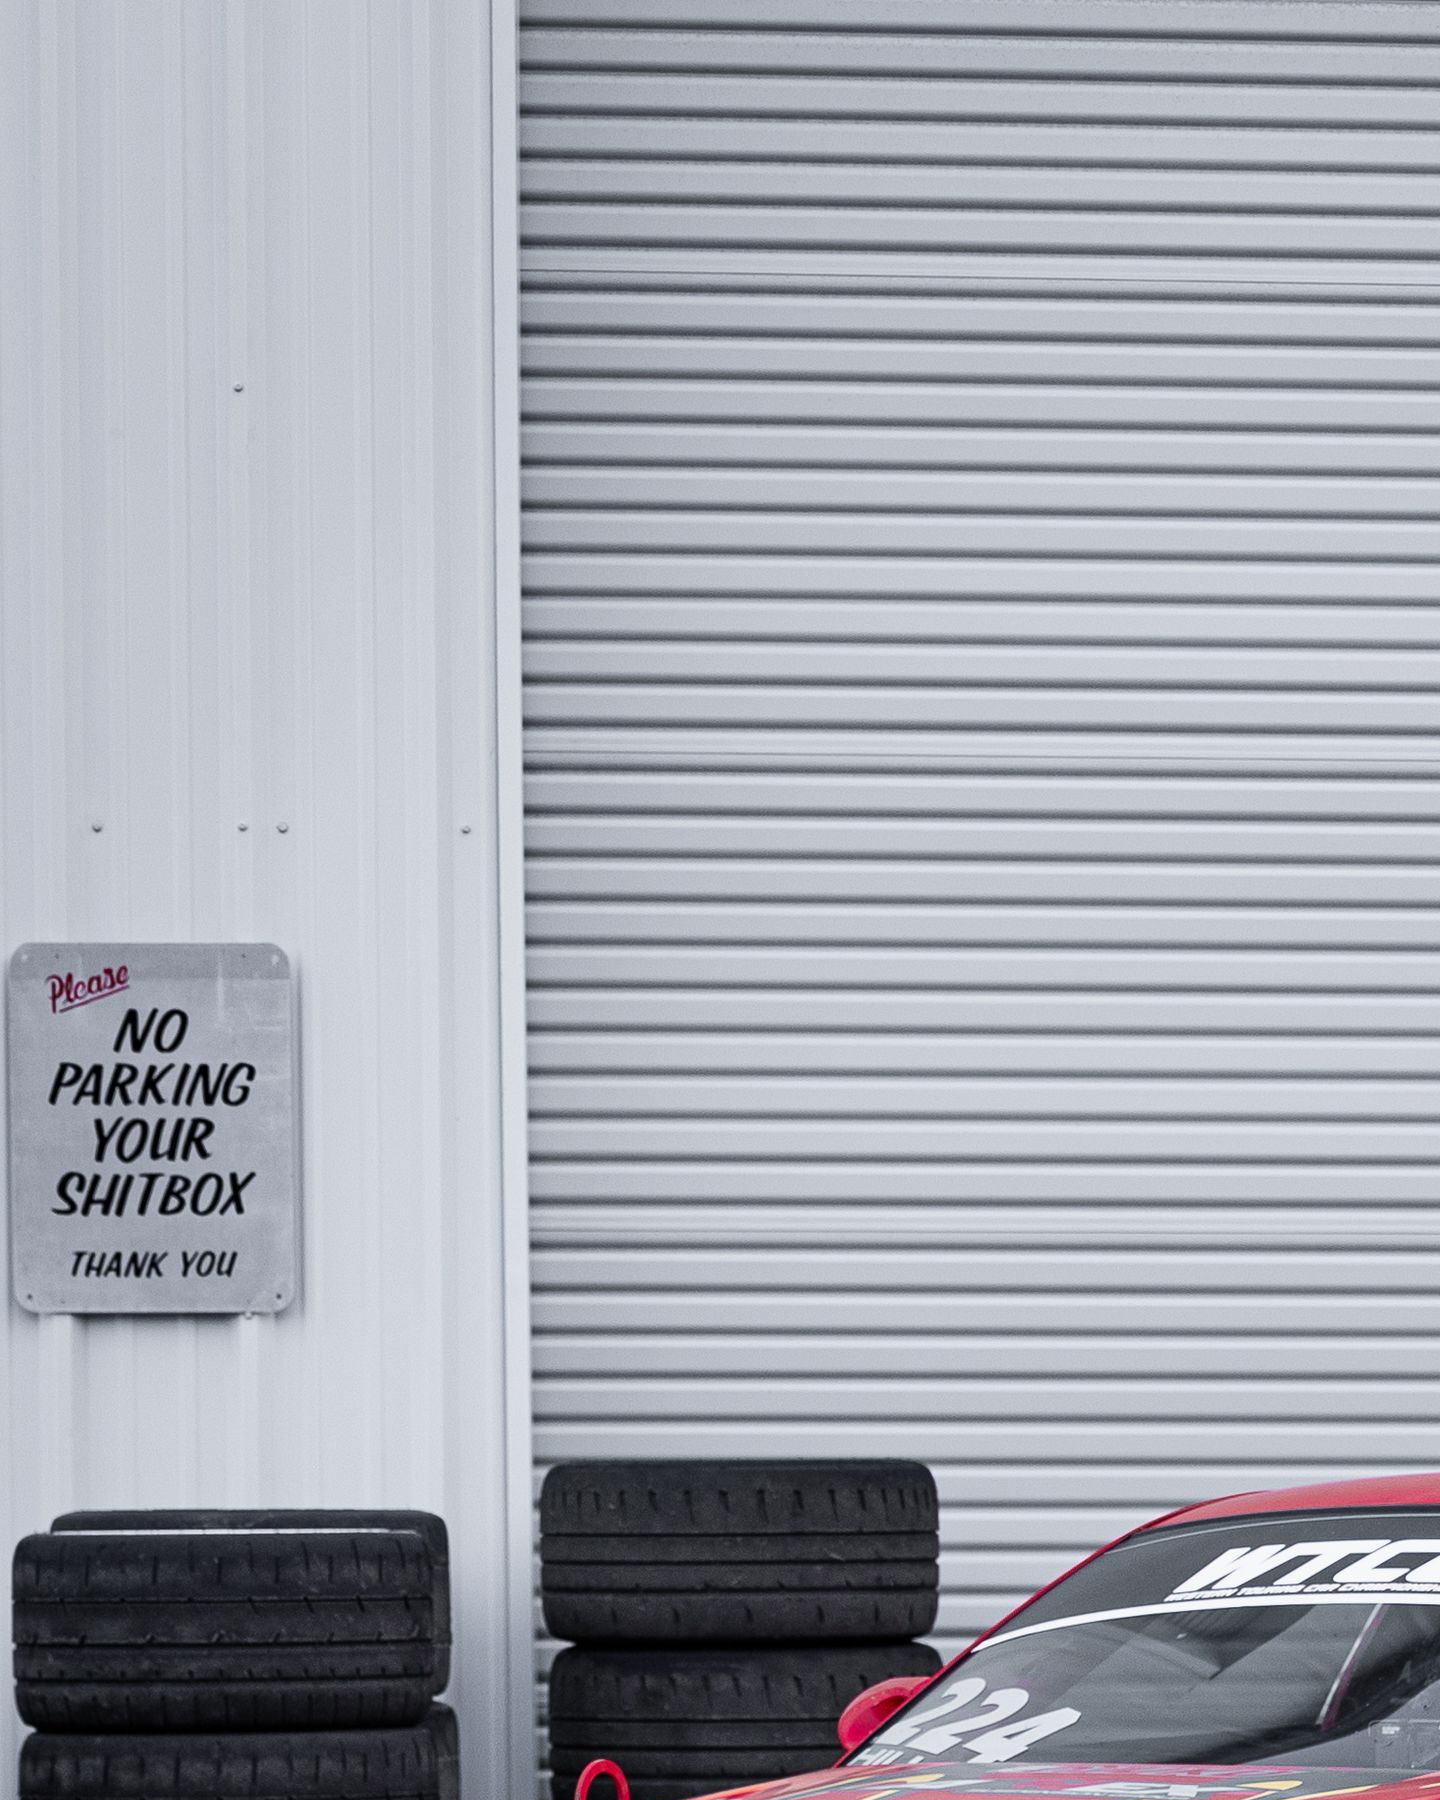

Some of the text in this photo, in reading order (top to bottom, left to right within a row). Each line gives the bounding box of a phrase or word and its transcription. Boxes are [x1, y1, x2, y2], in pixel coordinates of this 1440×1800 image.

[47, 964, 130, 1014] Please
[113, 1007, 189, 1054] NO
[48, 1062, 257, 1107] PARKING
[93, 1115, 216, 1164] YOUR
[51, 1171, 257, 1218] SHITBOX
[71, 1250, 238, 1278] THANK YOU
[874, 1677, 1082, 1764] 224
